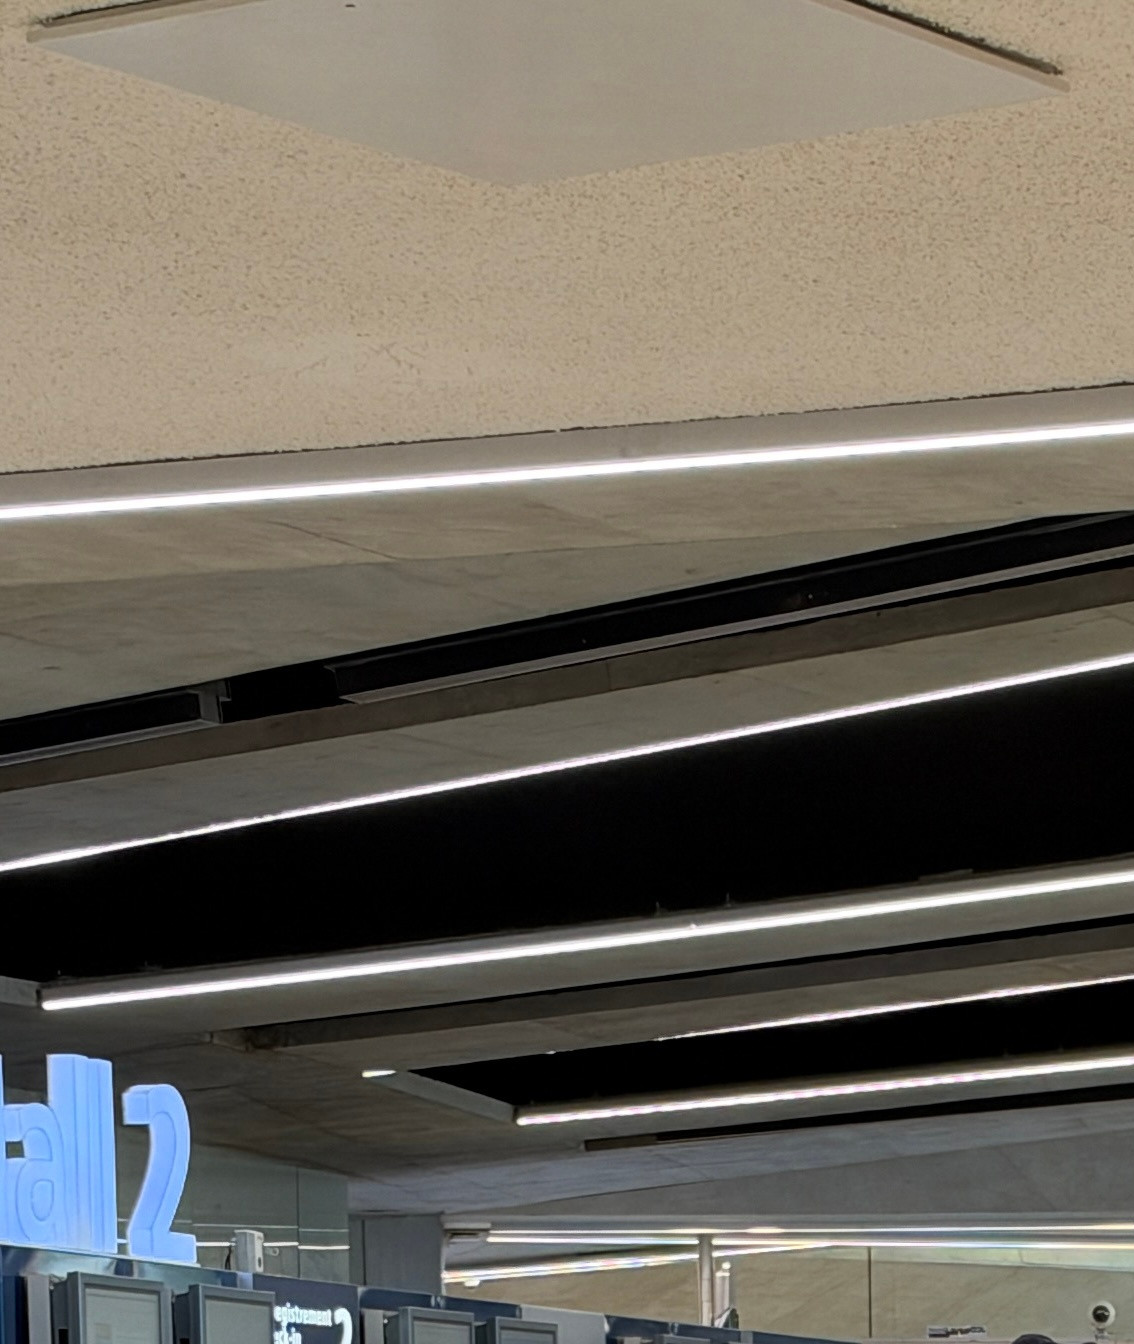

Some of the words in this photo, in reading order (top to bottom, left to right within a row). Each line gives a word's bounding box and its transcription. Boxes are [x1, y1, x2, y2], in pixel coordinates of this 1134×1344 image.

[0, 1053, 118, 1254] all
[121, 1083, 197, 1263] 2
[273, 1302, 332, 1327] egistrement
